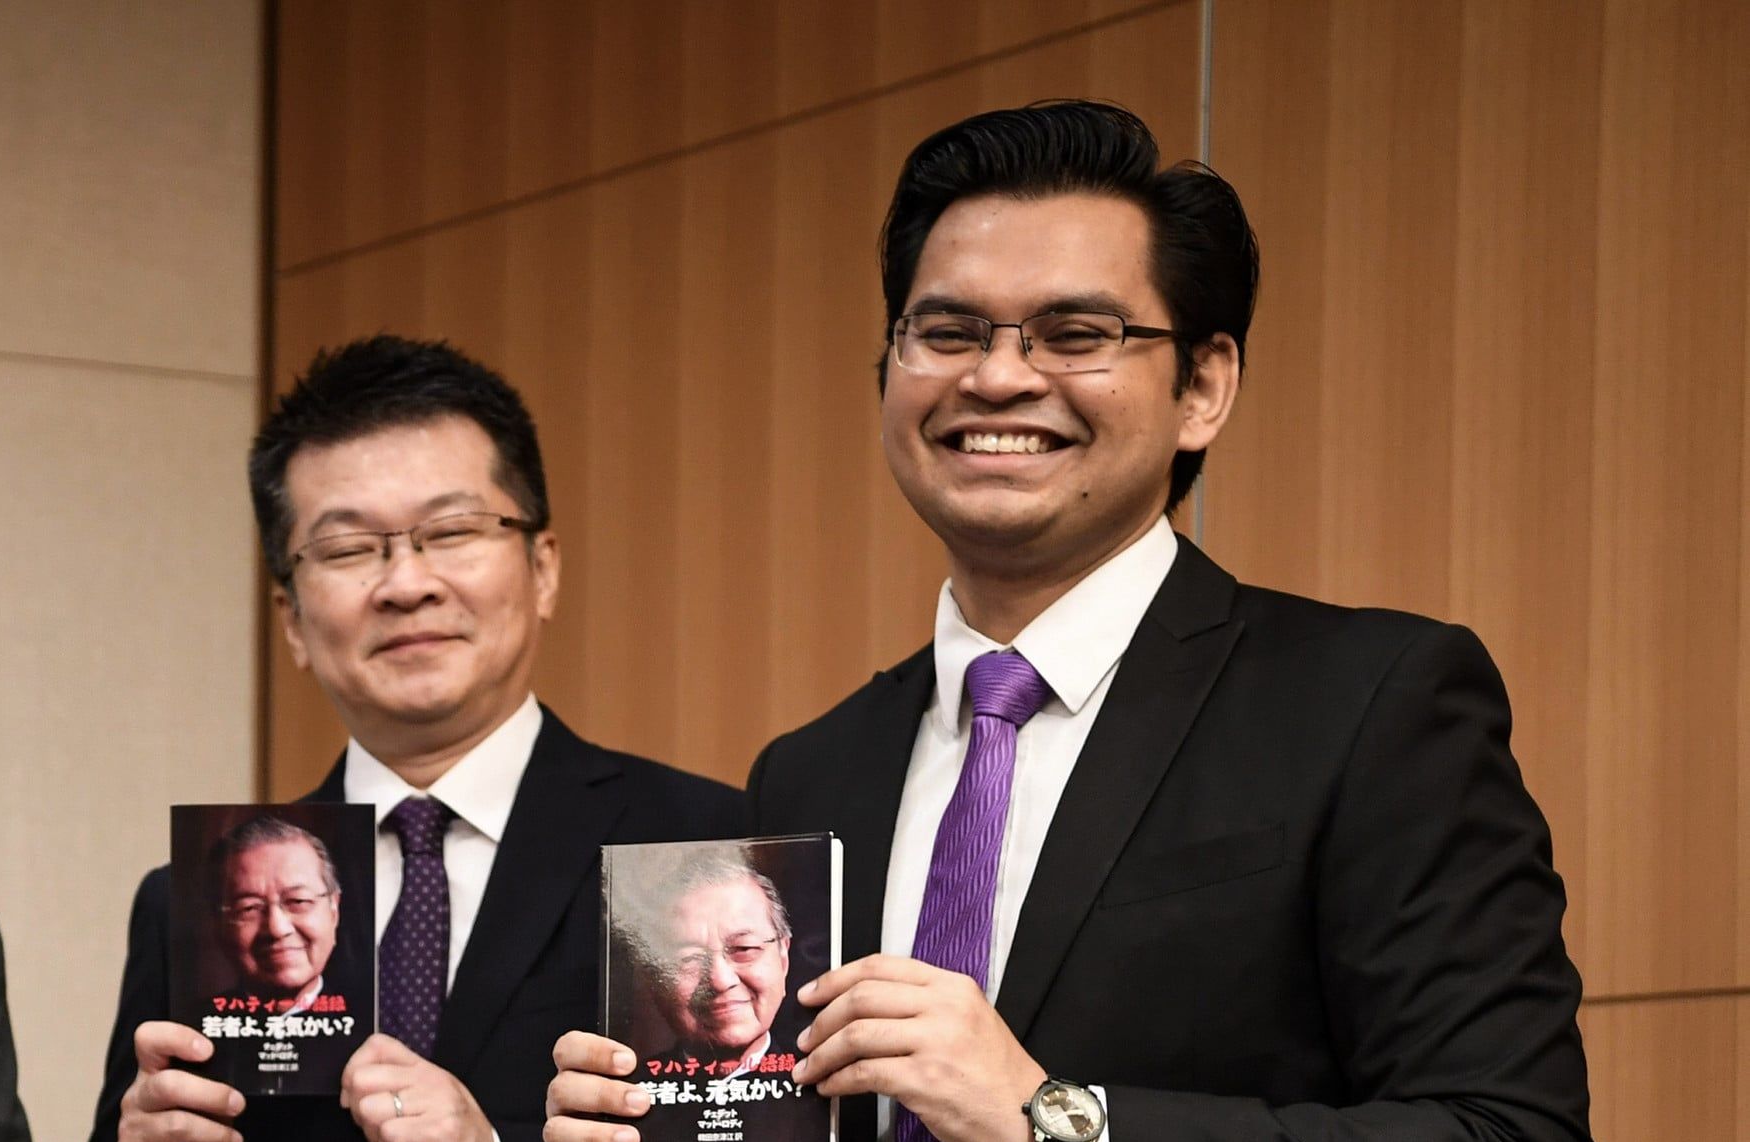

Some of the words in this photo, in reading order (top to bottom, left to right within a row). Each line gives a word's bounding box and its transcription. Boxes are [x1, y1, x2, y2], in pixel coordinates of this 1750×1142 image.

[202, 1016, 355, 1040] 若者よ、元気かい？
